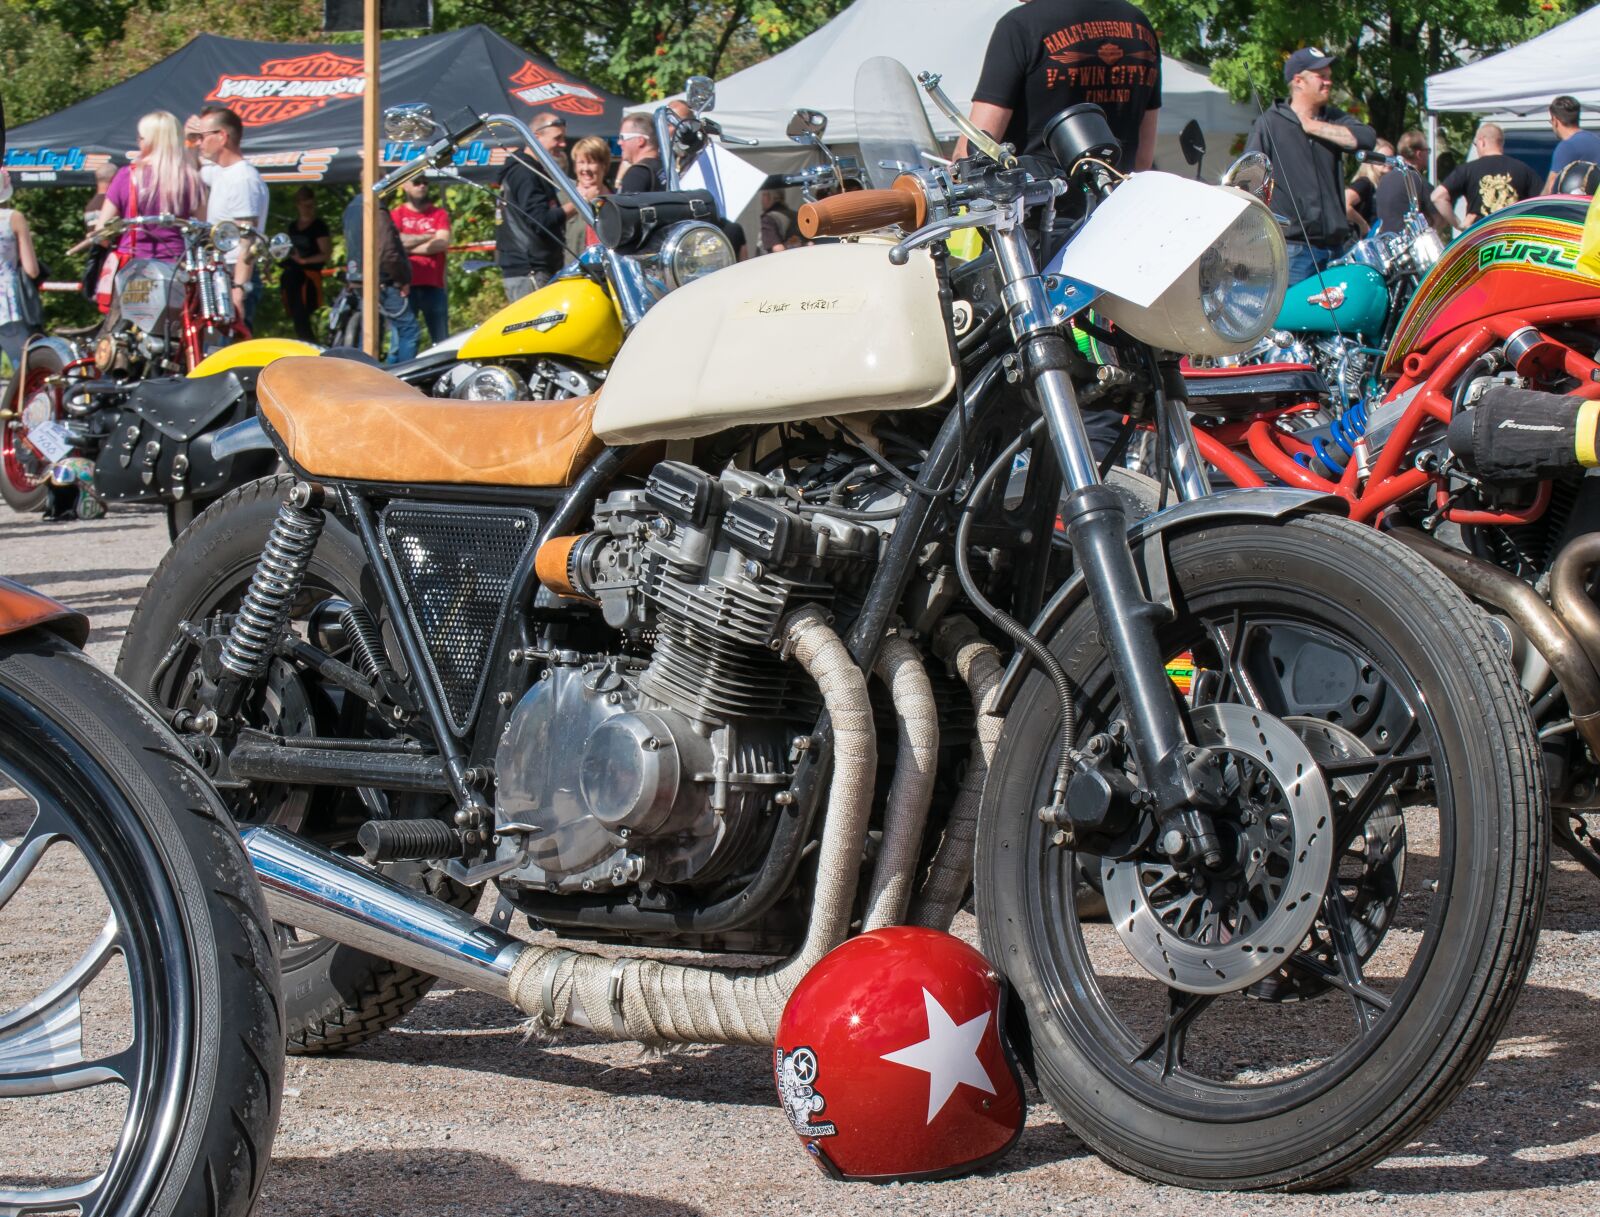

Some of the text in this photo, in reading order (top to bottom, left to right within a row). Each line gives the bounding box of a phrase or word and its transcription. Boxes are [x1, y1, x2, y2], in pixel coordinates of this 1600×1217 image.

[1043, 21, 1133, 54] HARLEY-DAVIDSON
[1046, 65, 1106, 89] V-TWIN
[1111, 65, 1146, 86] CITY
[1086, 89, 1131, 103] FINLAND
